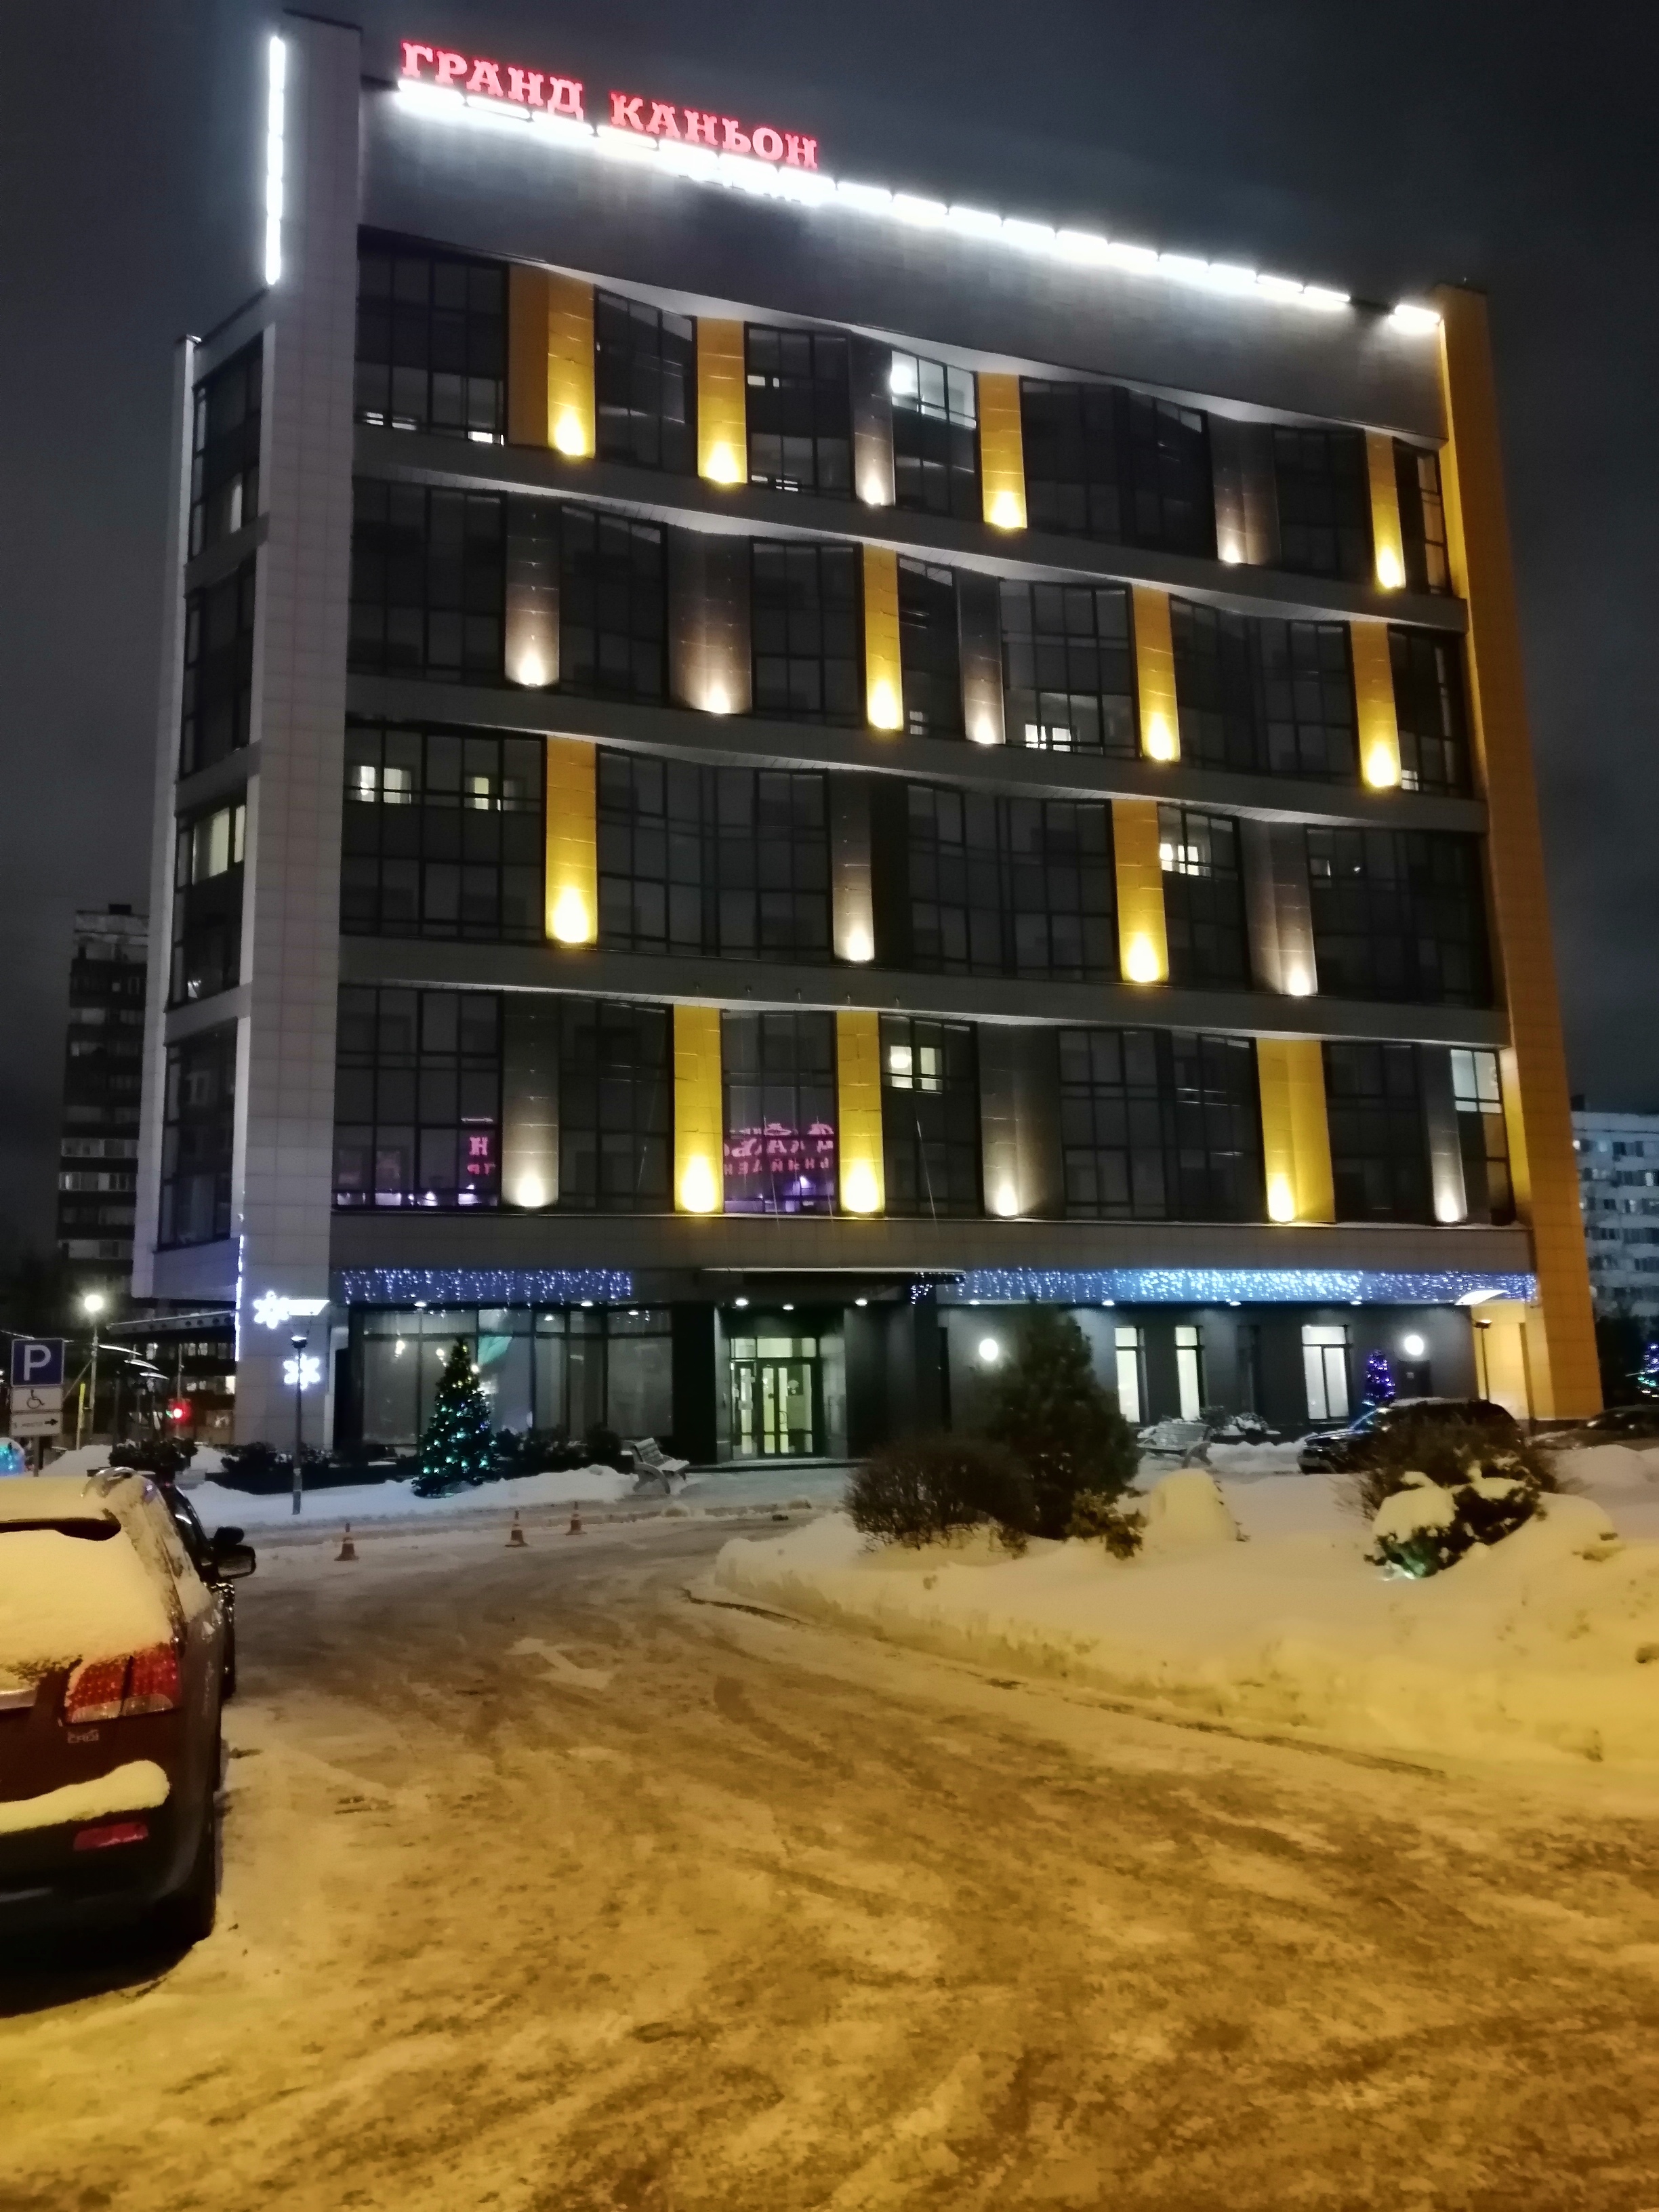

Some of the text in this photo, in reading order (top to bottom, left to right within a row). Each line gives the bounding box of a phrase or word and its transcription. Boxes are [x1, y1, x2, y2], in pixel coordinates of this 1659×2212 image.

[402, 41, 818, 169] ГРАНД КАНЬОН
[23, 1345, 52, 1381] P
